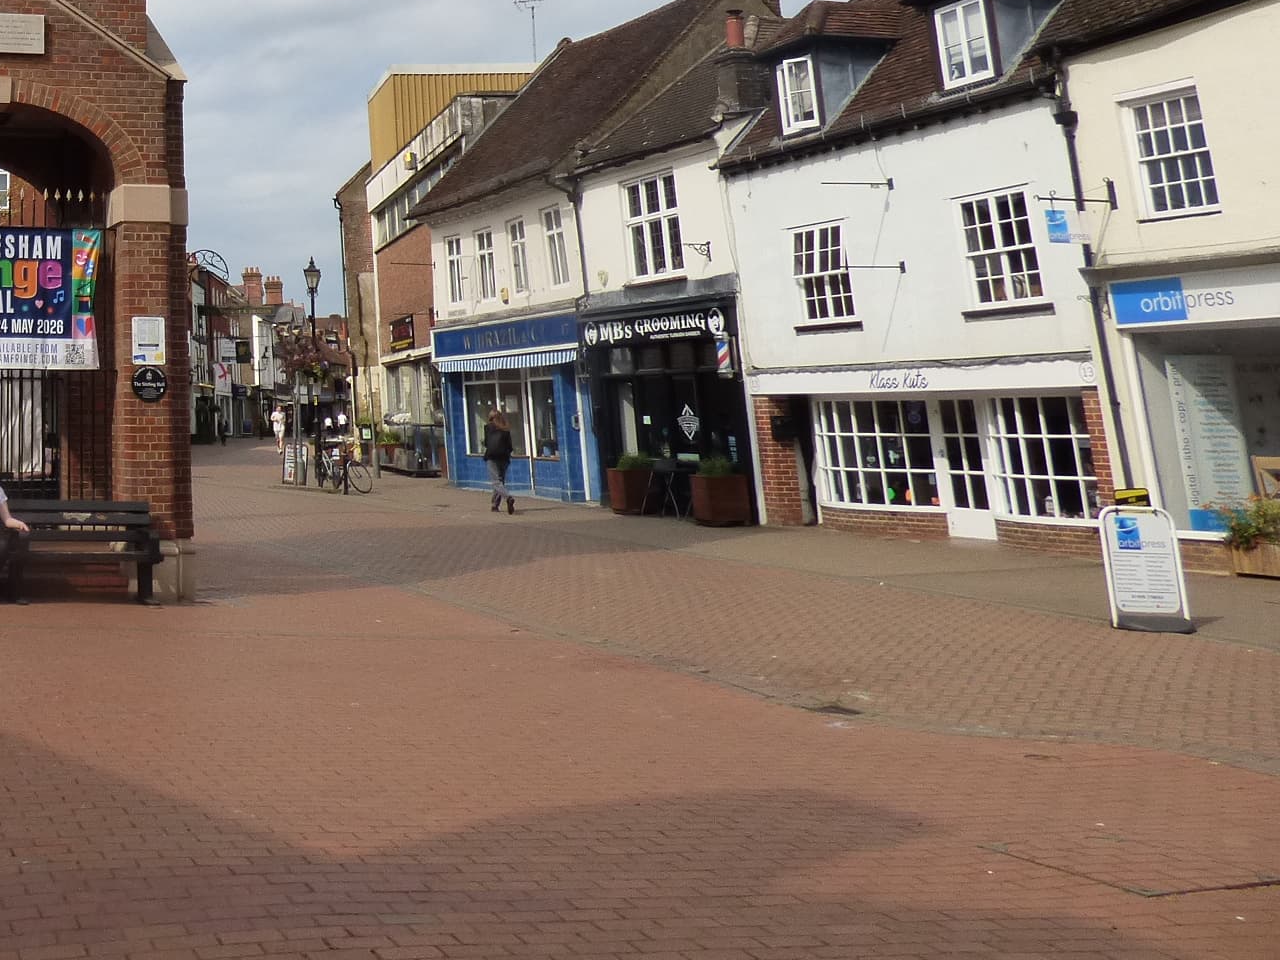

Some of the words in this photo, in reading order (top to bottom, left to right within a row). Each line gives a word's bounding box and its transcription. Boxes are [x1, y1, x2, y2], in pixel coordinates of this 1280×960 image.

[1140, 289, 1234, 314] orbitpress
[11, 319, 35, 334] MAY
[37, 319, 64, 334] 2026
[599, 321, 633, 344] MB's
[634, 312, 706, 336] GROOMING
[35, 343, 58, 353] FROM
[869, 368, 899, 388] Klass
[903, 370, 929, 388] Kuts
[1082, 366, 1094, 378] 13
[1176, 400, 1187, 424] copy
[1182, 437, 1192, 461] litho
[1188, 473, 1200, 506] digital
[1119, 538, 1167, 549] orbitpress
